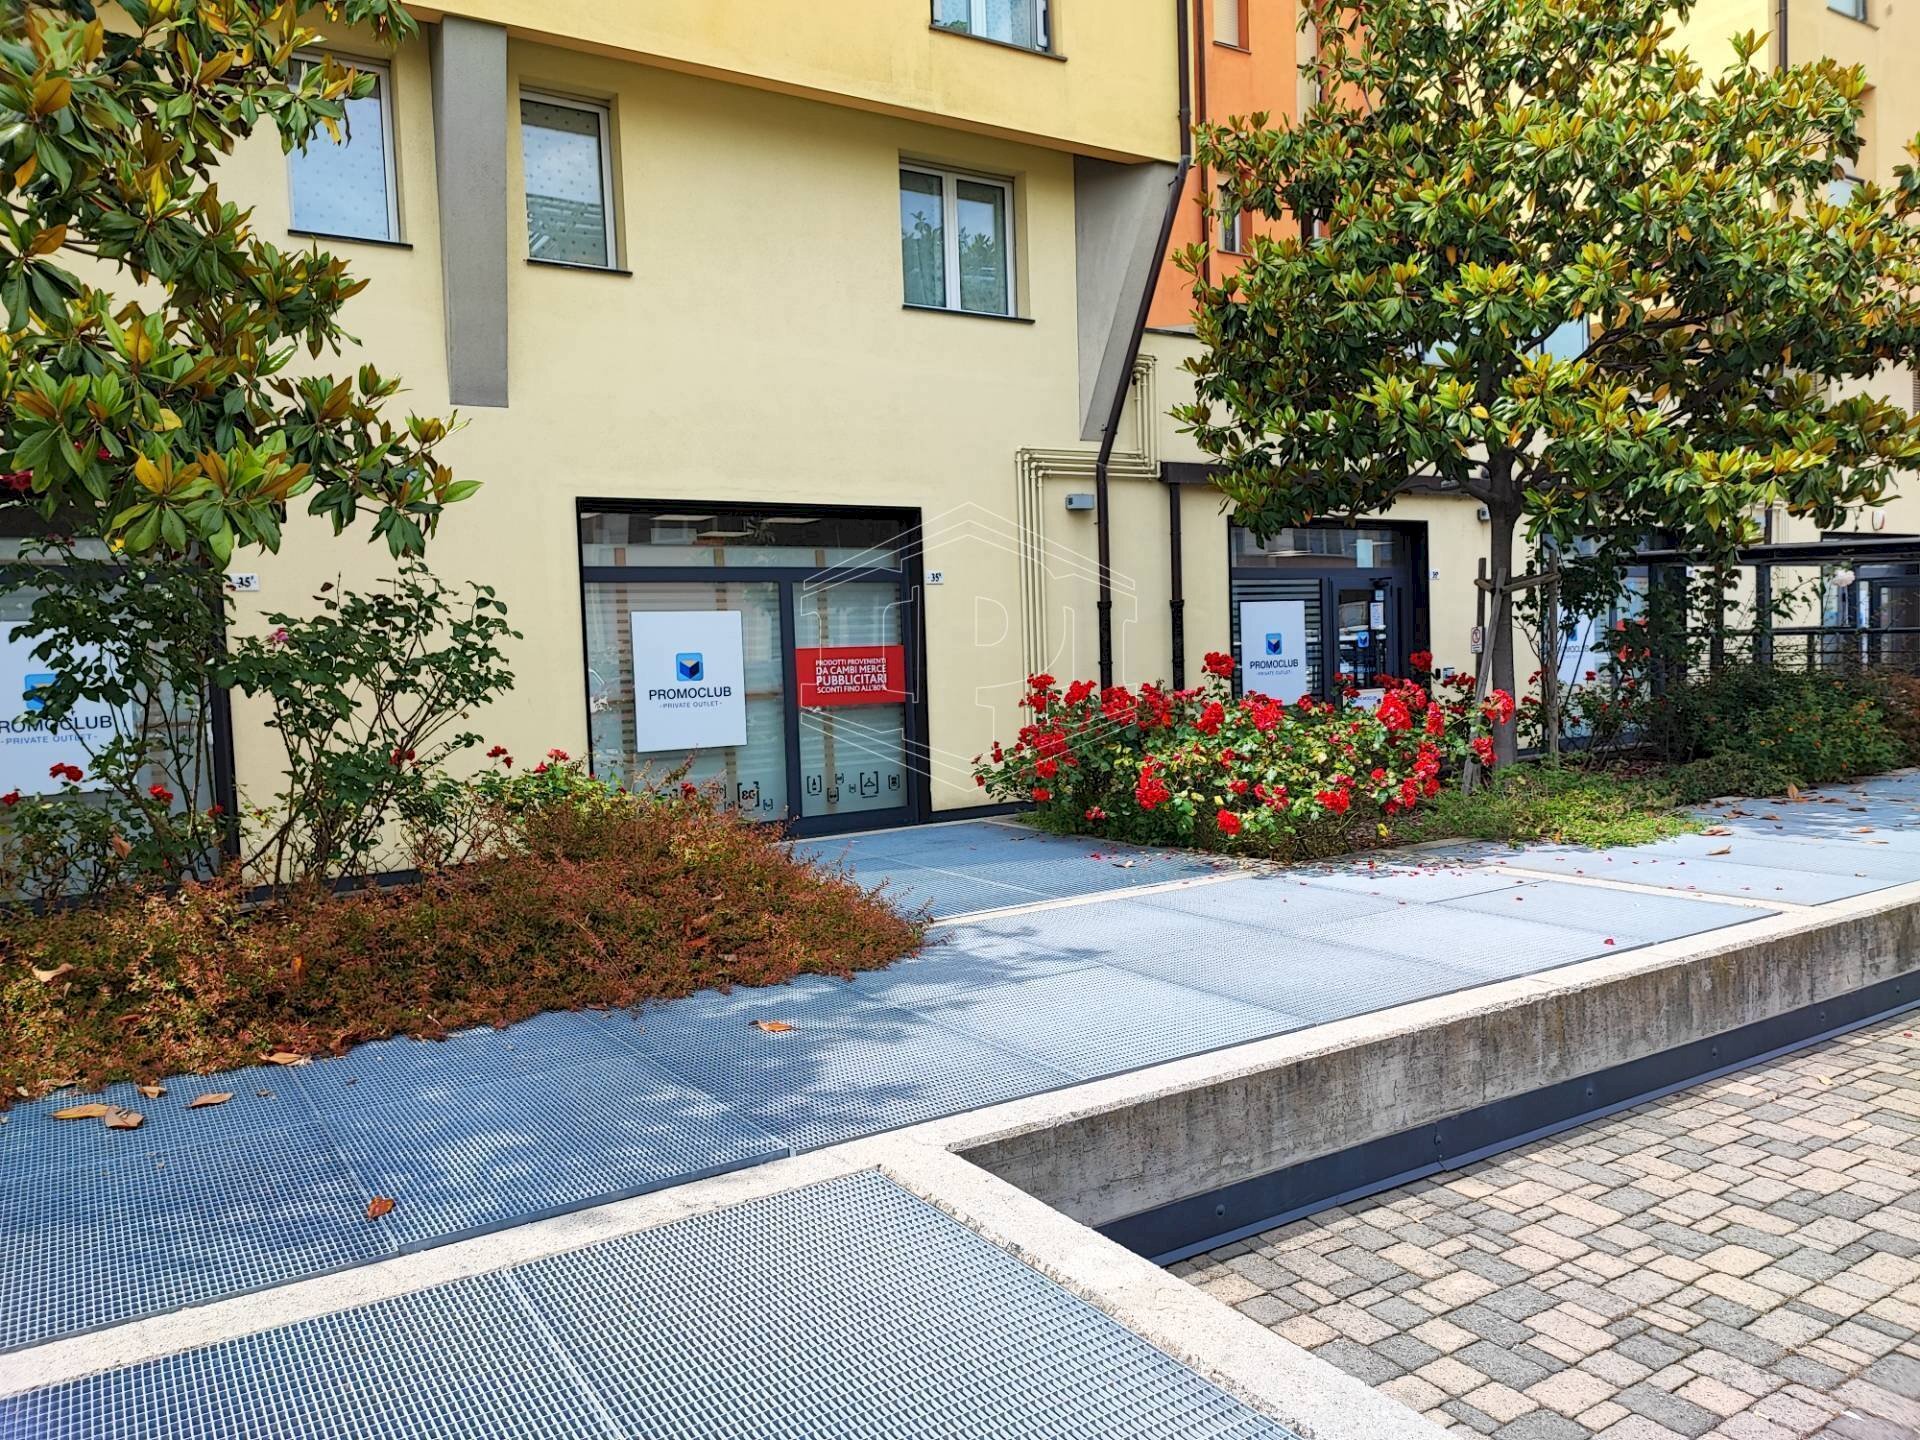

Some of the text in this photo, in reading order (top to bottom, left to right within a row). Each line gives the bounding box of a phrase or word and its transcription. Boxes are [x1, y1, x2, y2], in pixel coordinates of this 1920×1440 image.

[816, 664, 886, 675] DA CAMBI MERCE
[1249, 659, 1299, 669] PROMOCLUB
[816, 673, 887, 686] PUBBLICITARI
[648, 686, 732, 701] PROMOCLUB
[0, 715, 112, 734] ROMOCLUB
